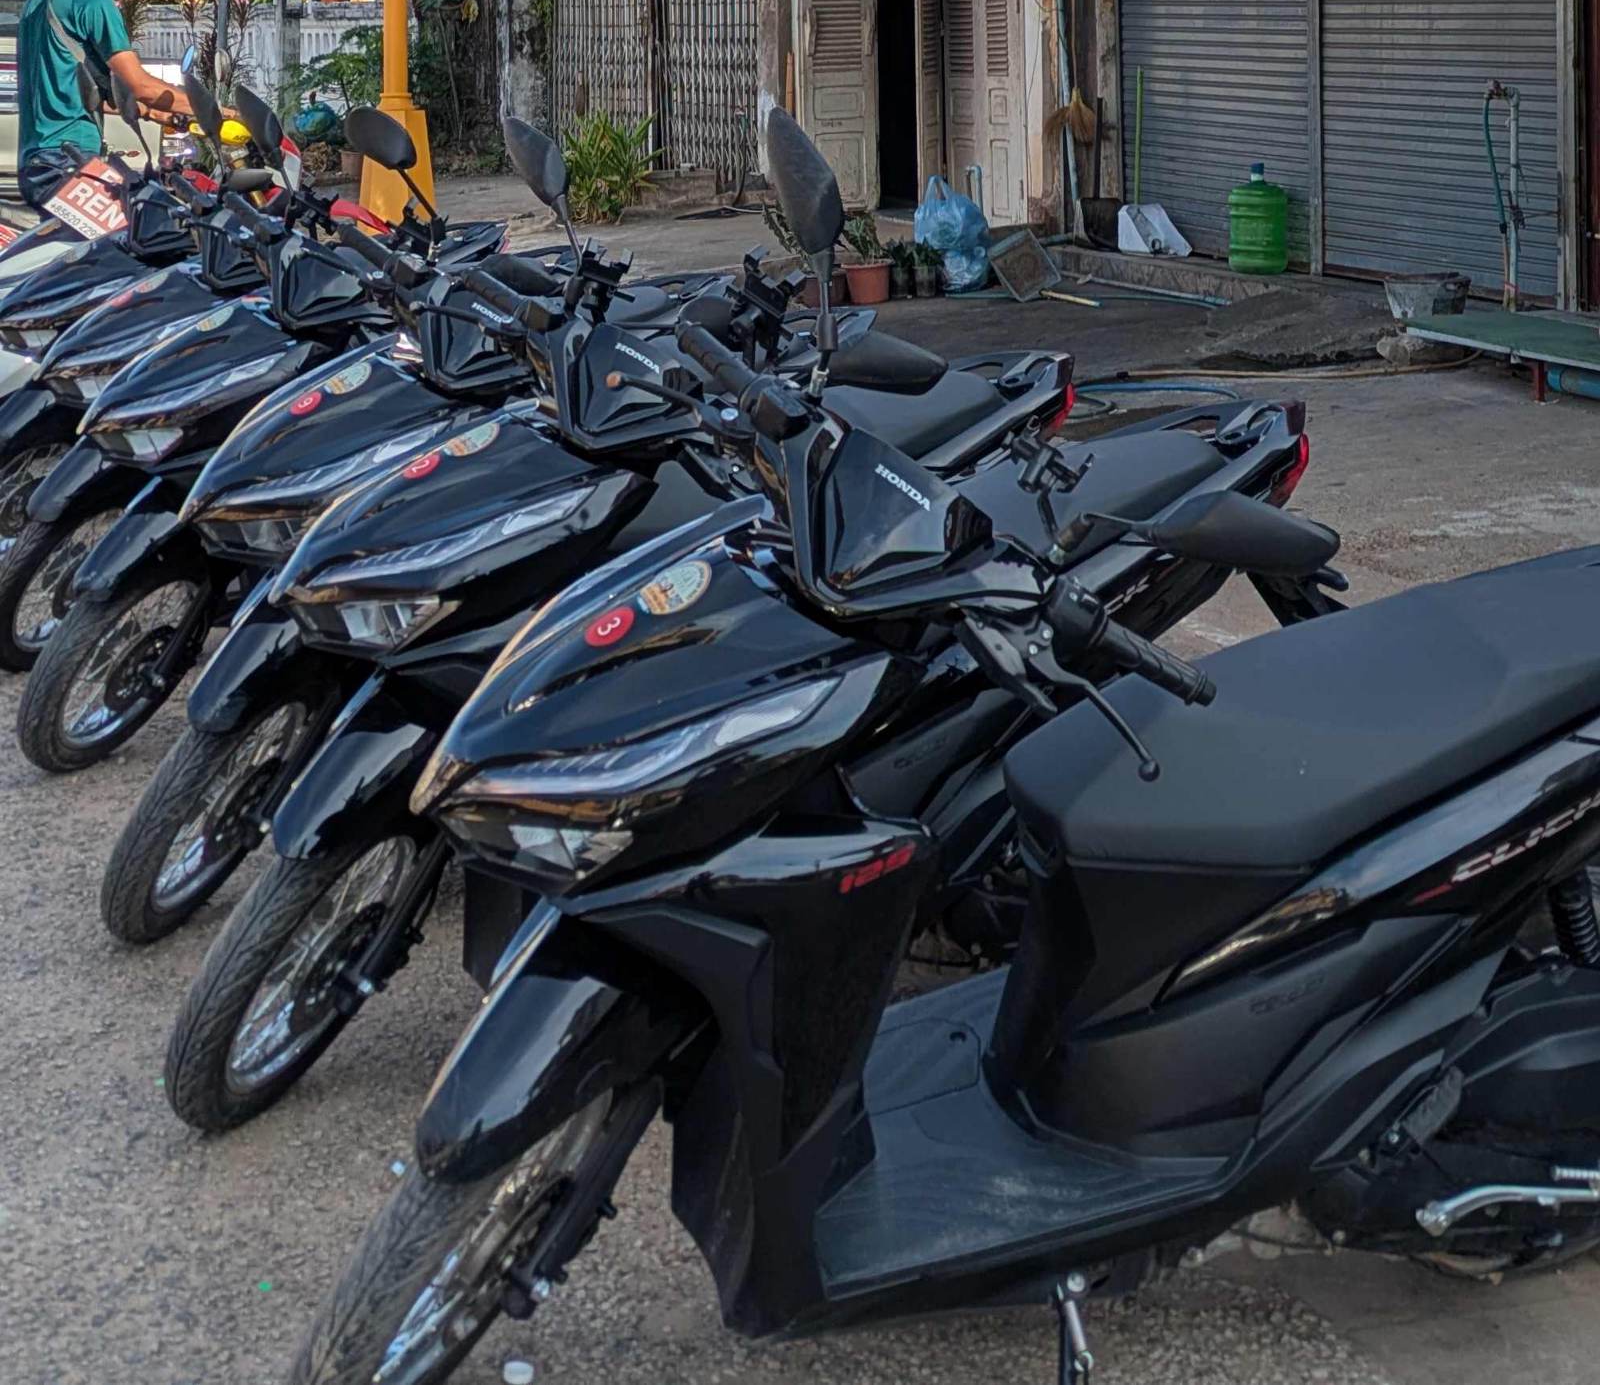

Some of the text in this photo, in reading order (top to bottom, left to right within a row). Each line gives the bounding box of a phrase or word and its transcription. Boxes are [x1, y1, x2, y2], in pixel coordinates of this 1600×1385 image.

[615, 342, 660, 375] HONDA
[411, 459, 430, 473] 2
[875, 463, 931, 512] HONDA
[597, 616, 621, 636] 3
